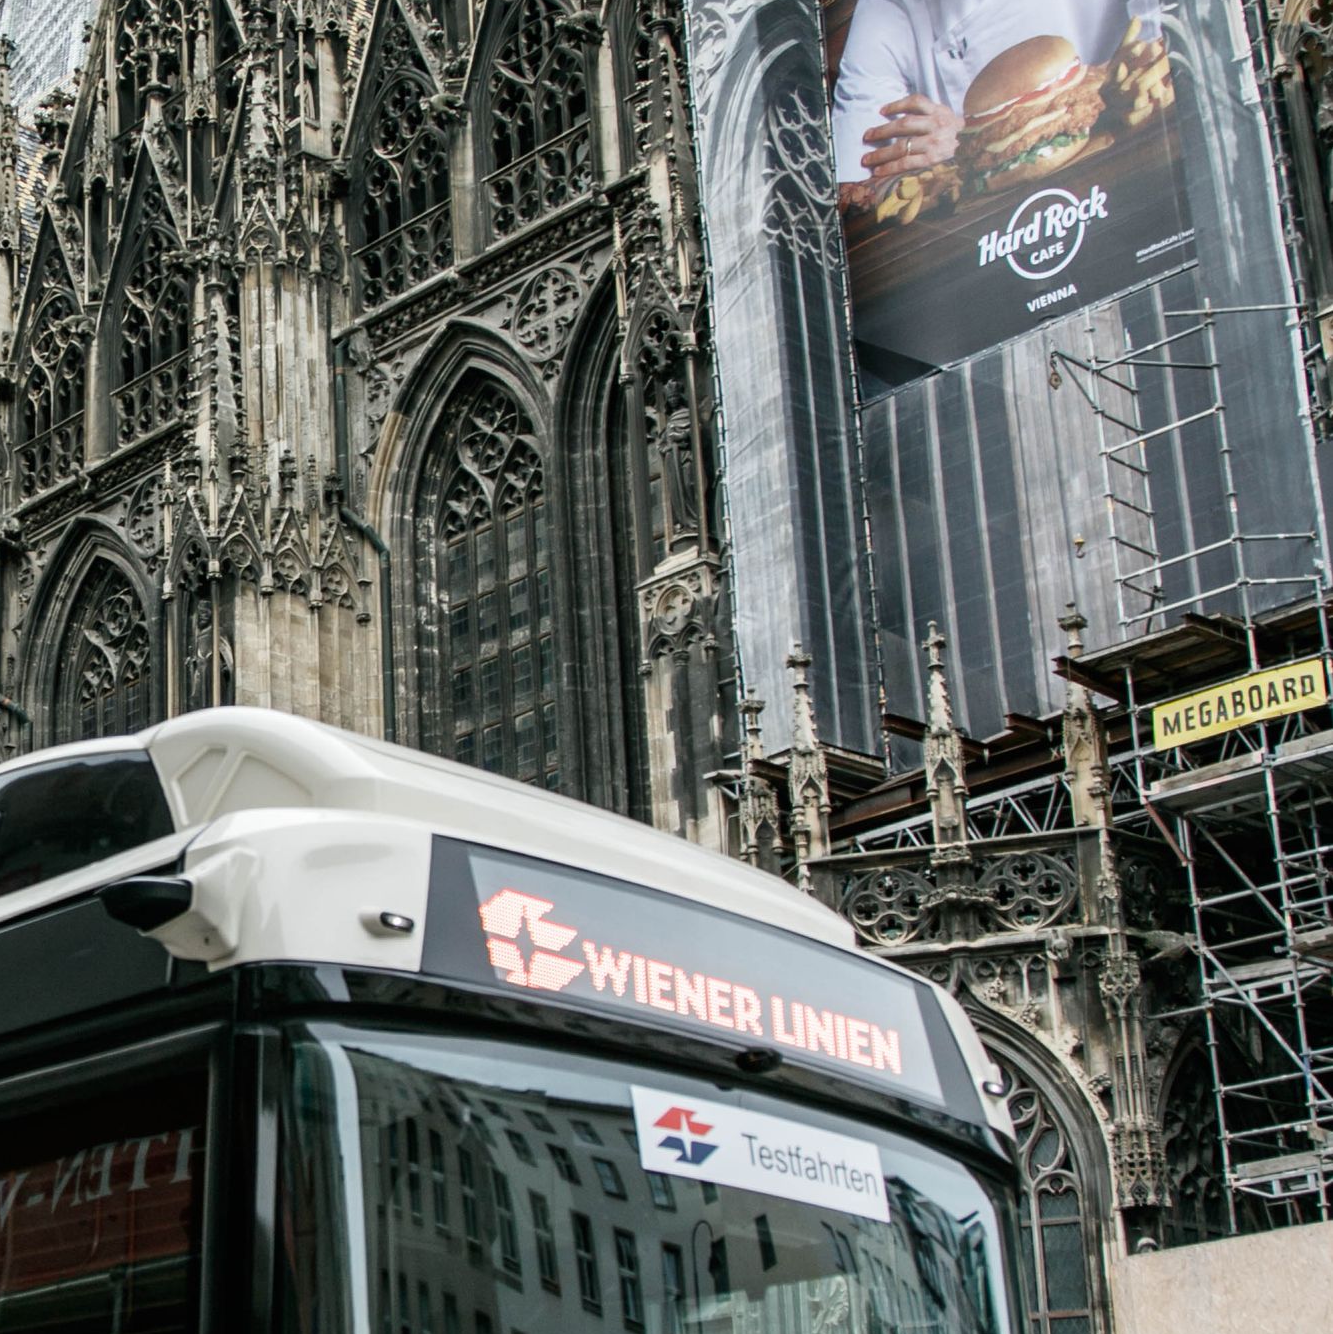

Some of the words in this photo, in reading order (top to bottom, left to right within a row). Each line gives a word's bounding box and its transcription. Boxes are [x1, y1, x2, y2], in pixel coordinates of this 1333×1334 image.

[978, 211, 1042, 266] Hard
[1043, 185, 1109, 239] Rock
[1030, 241, 1065, 265] CAFE
[1026, 283, 1078, 313] VIENNA
[1162, 673, 1316, 738] MEGABOARD
[581, 940, 763, 1036] WIENER
[770, 995, 901, 1074] LINIEN
[741, 1132, 879, 1197] Testfahrten
